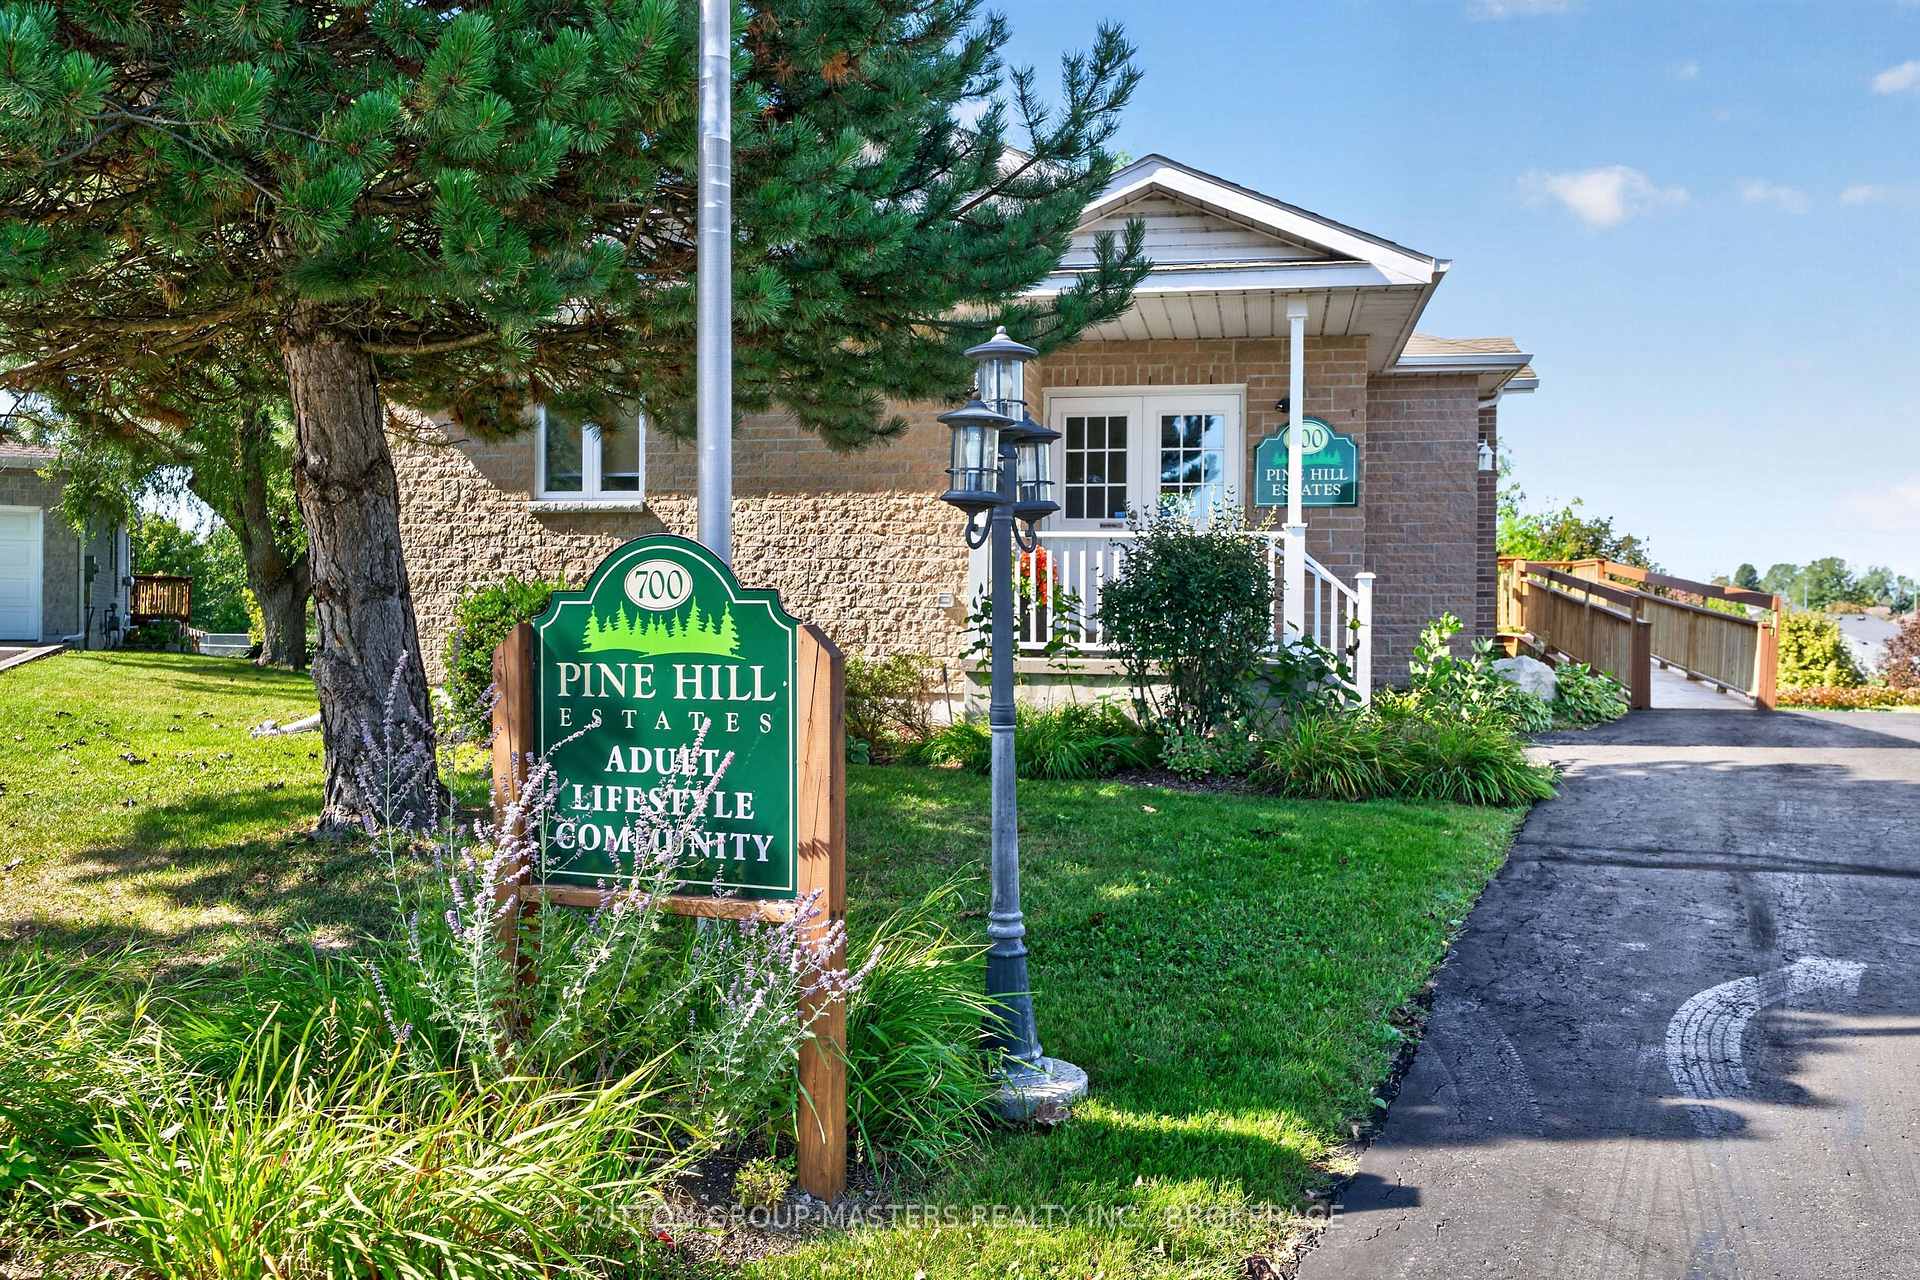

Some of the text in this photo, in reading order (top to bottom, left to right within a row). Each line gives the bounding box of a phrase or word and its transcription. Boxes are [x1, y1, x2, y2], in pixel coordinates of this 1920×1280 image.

[1266, 468, 1349, 481] PIN HILL
[1272, 483, 1341, 496] ESATES
[635, 570, 683, 600] 700
[556, 662, 777, 701] PINE HILL
[560, 707, 773, 733] ESTATES
[604, 745, 719, 777] ADULT
[571, 784, 755, 820] LIFESTYLE
